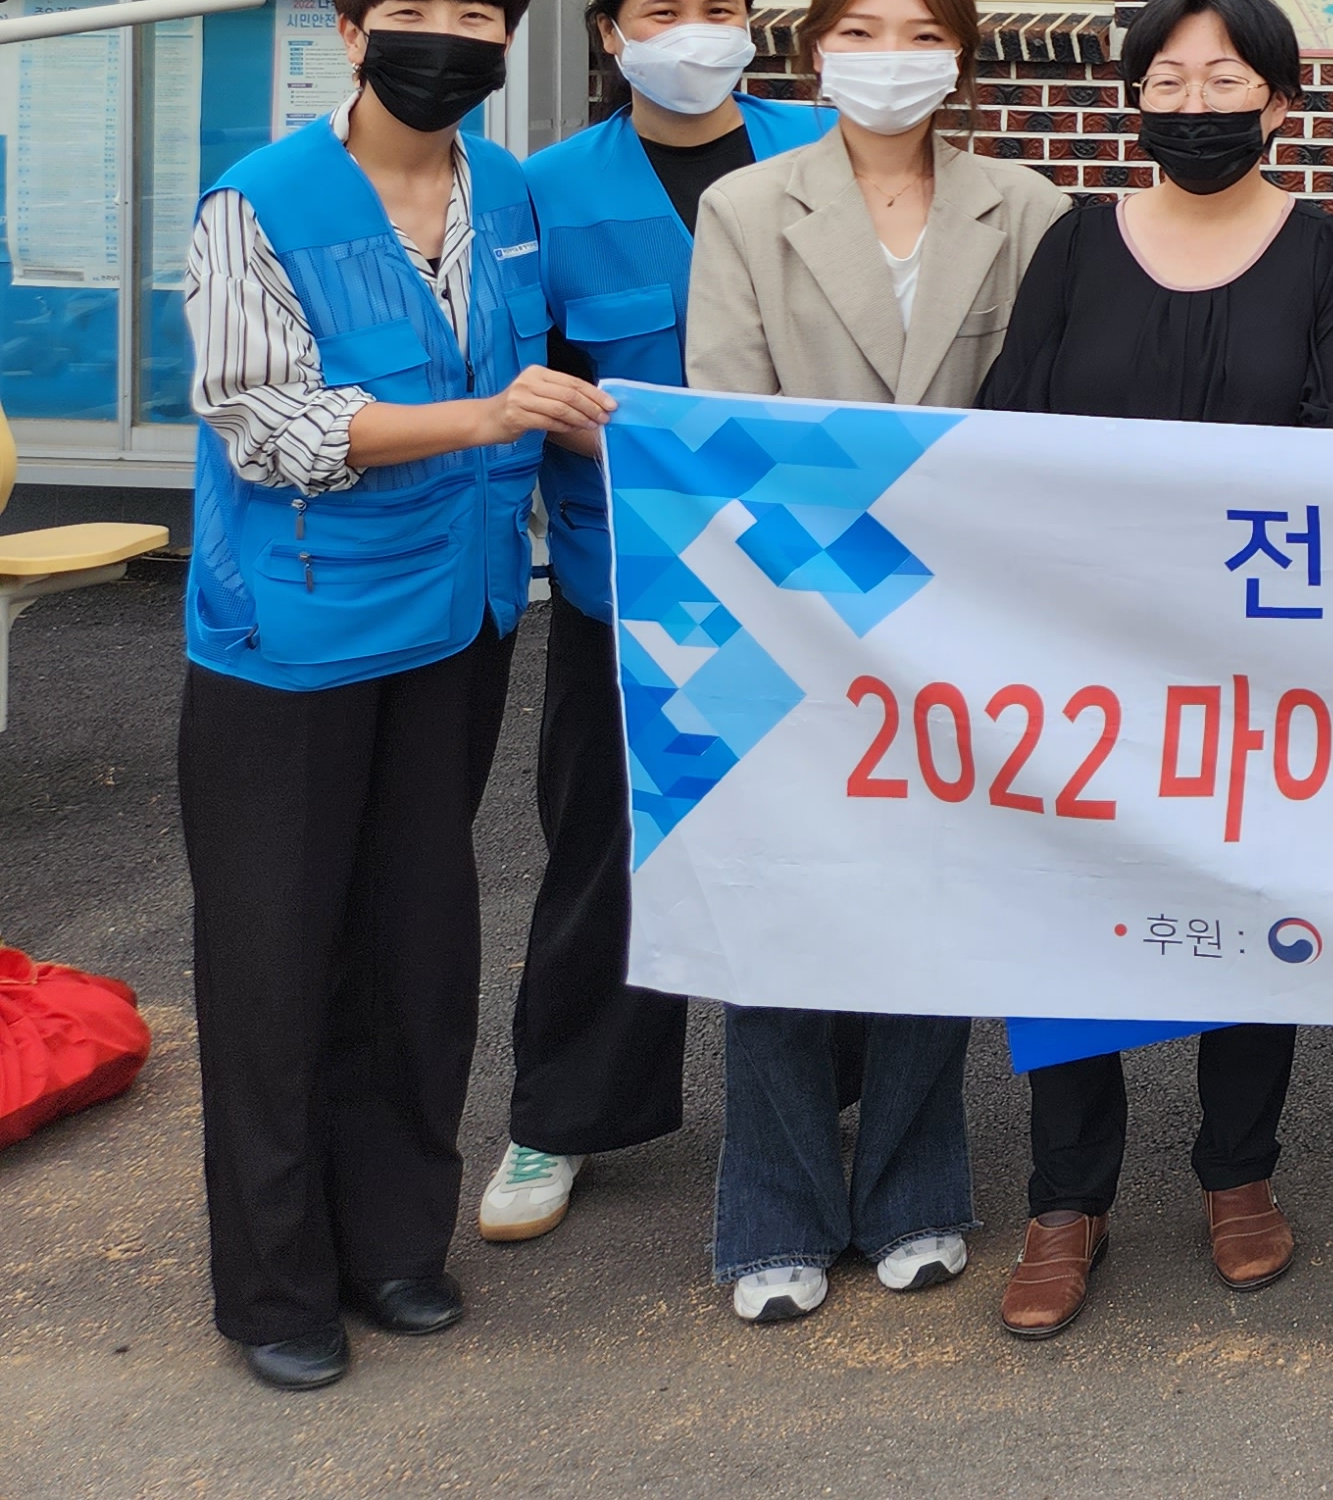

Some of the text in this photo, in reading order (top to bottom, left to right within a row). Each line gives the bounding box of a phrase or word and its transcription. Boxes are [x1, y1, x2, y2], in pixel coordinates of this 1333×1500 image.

[286, 13, 336, 29] 시민안전
[846, 674, 1122, 821] 2022
[1142, 913, 1223, 959] 후원
